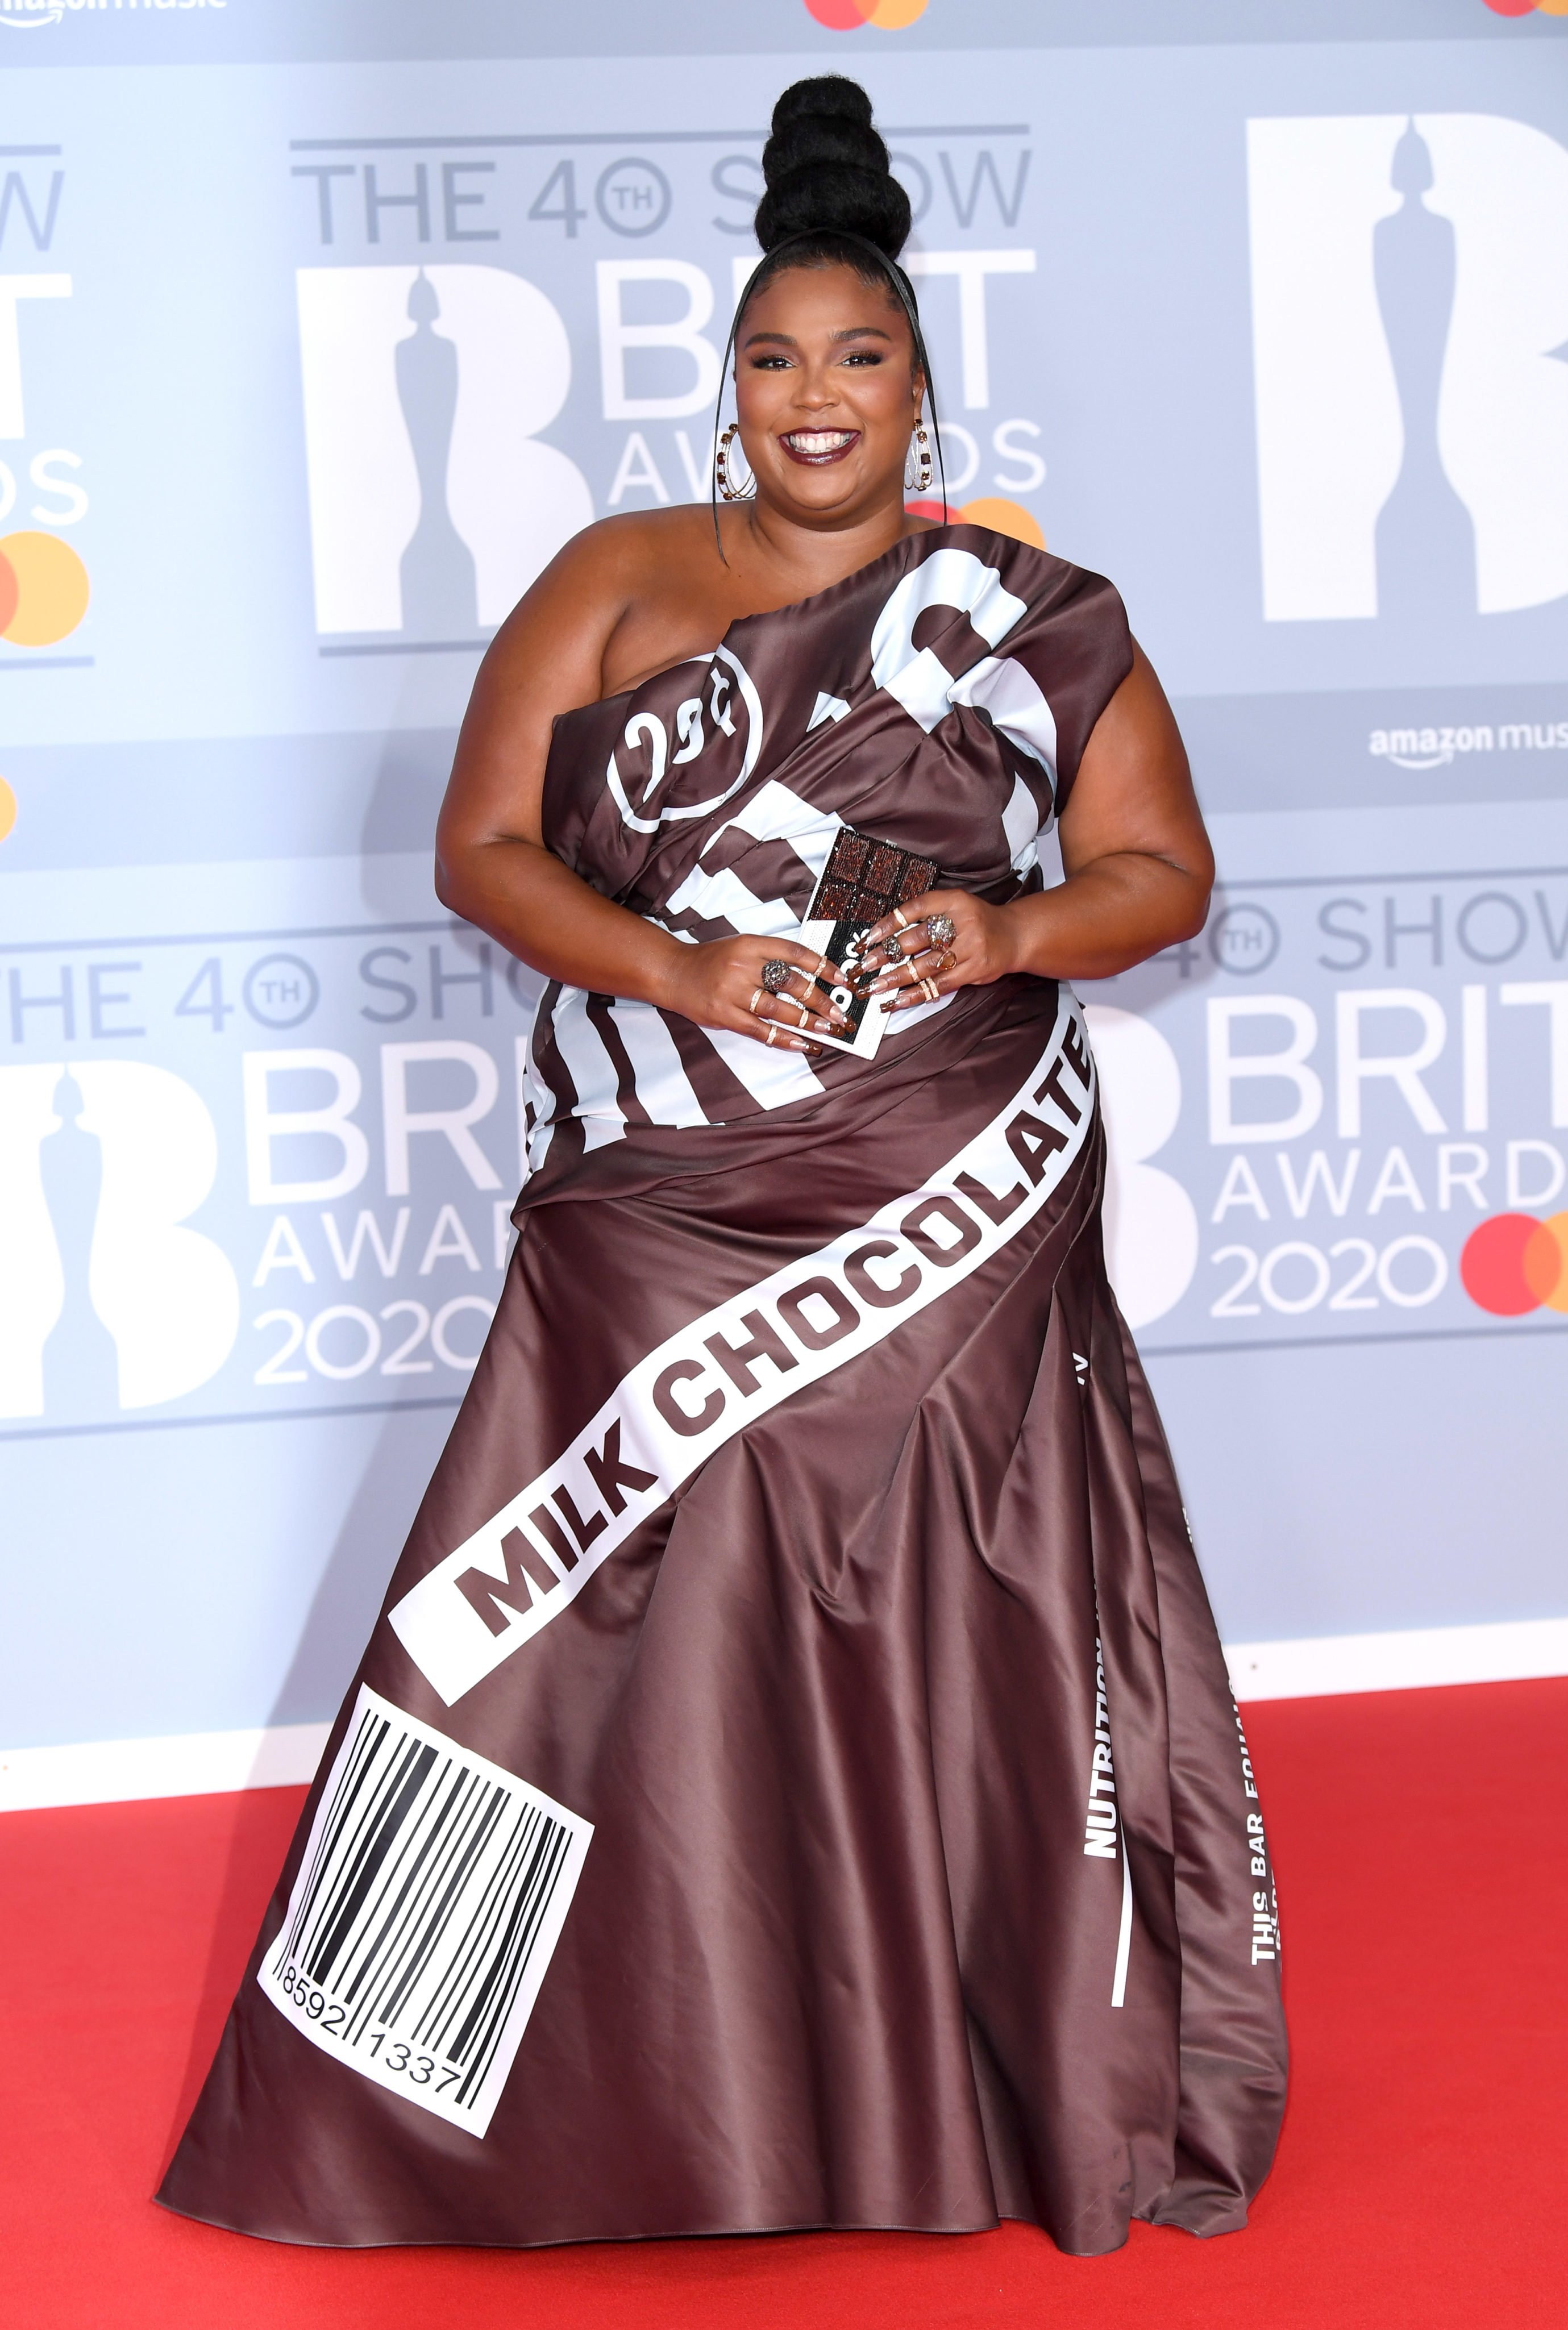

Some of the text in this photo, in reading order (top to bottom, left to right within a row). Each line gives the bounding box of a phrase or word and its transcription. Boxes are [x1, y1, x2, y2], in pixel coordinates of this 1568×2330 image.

[291, 161, 500, 245] THE
[710, 150, 1032, 234] SW
[611, 185, 653, 211] TH
[595, 249, 1037, 421] BT
[1369, 721, 1568, 756] amazon mus
[1224, 929, 1263, 951] TH
[8, 961, 147, 1045] HE
[359, 943, 537, 1023] SH
[259, 980, 300, 1003] TH
[242, 1035, 529, 1206] BR
[1211, 1139, 1567, 1224] AWARD
[252, 1200, 511, 1288] AWA
[1210, 1234, 1449, 1318] 2020
[252, 1295, 495, 1385] 2020
[453, 1416, 659, 1638] MILK
[651, 1014, 1091, 1438] CHOCOLATE
[1083, 1637, 1116, 1859] NUTRITI
[1247, 1813, 1267, 1877] BAR
[1251, 1891, 1276, 1966] THIS
[282, 1965, 461, 2094] 8592 1337
